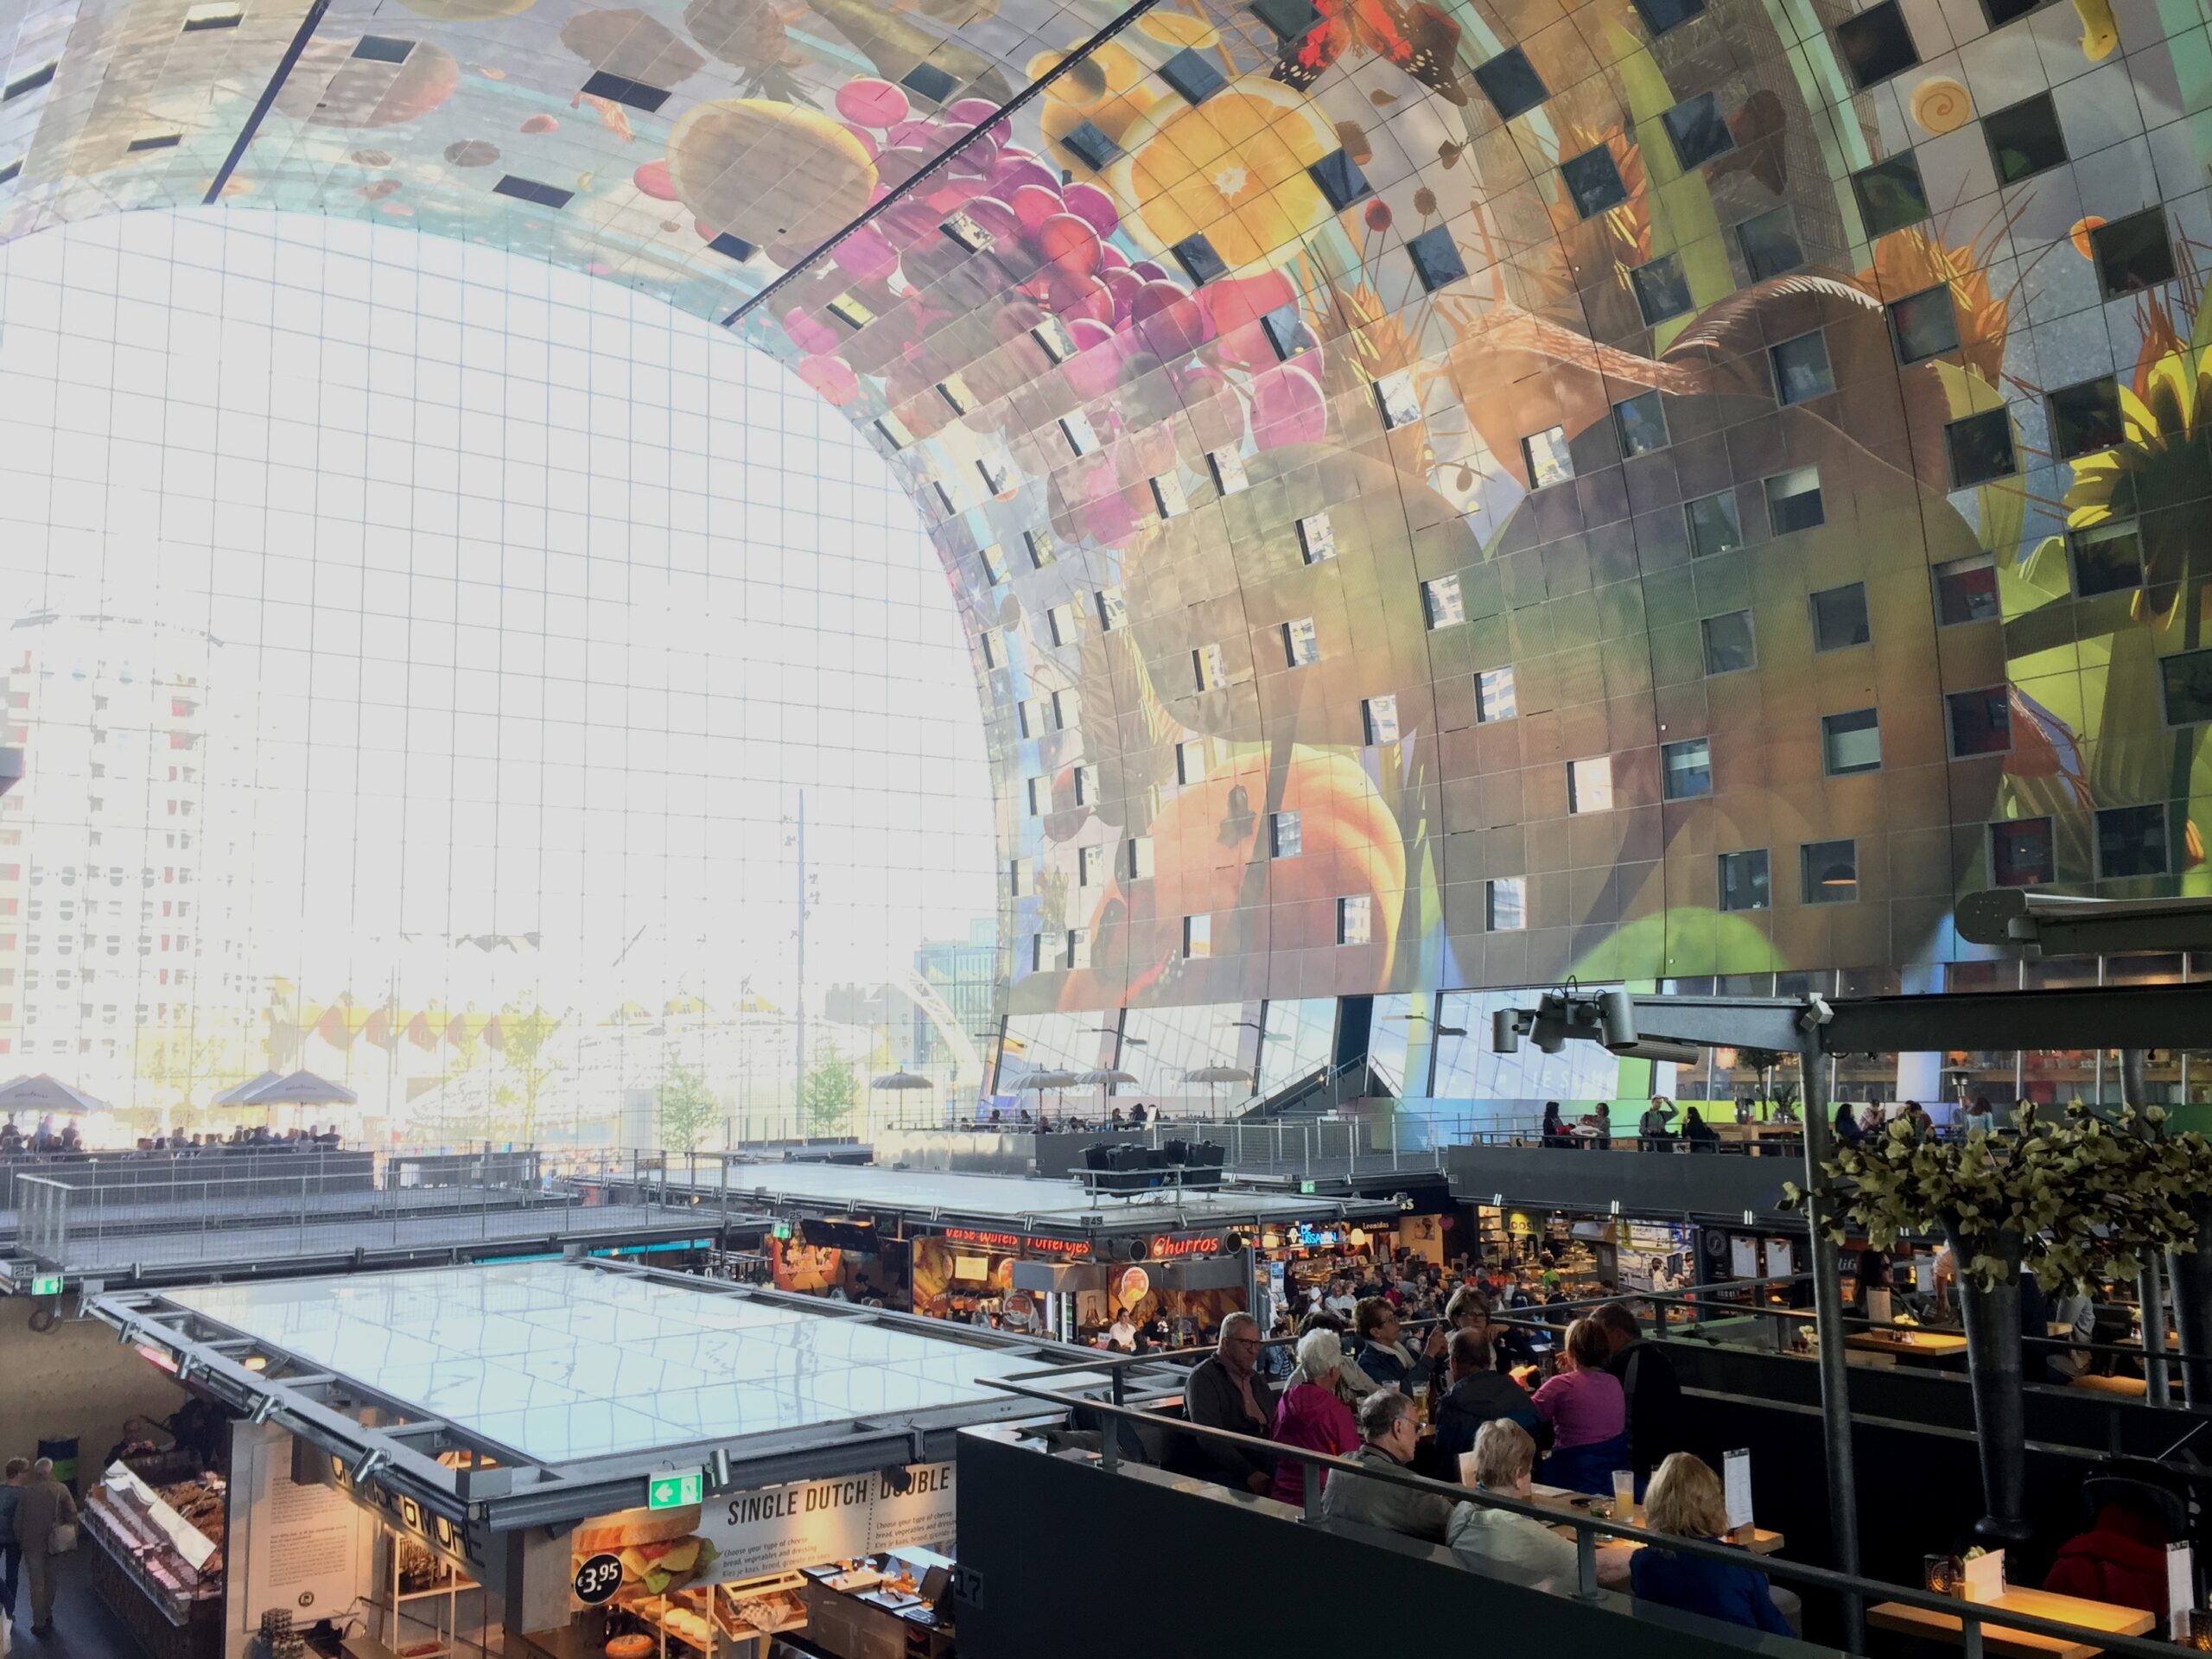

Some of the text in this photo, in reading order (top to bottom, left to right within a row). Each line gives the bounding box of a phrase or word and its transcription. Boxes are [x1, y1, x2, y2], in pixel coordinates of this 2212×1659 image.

[790, 1211, 803, 1220] 25
[1090, 1216, 1103, 1225] 49
[1153, 1236, 1218, 1257] Churros
[15, 1266, 35, 1277] 25
[880, 1466, 950, 1499] DUBLE
[728, 1478, 868, 1526] SINGLE DUTCH
[955, 1568, 982, 1603] 17
